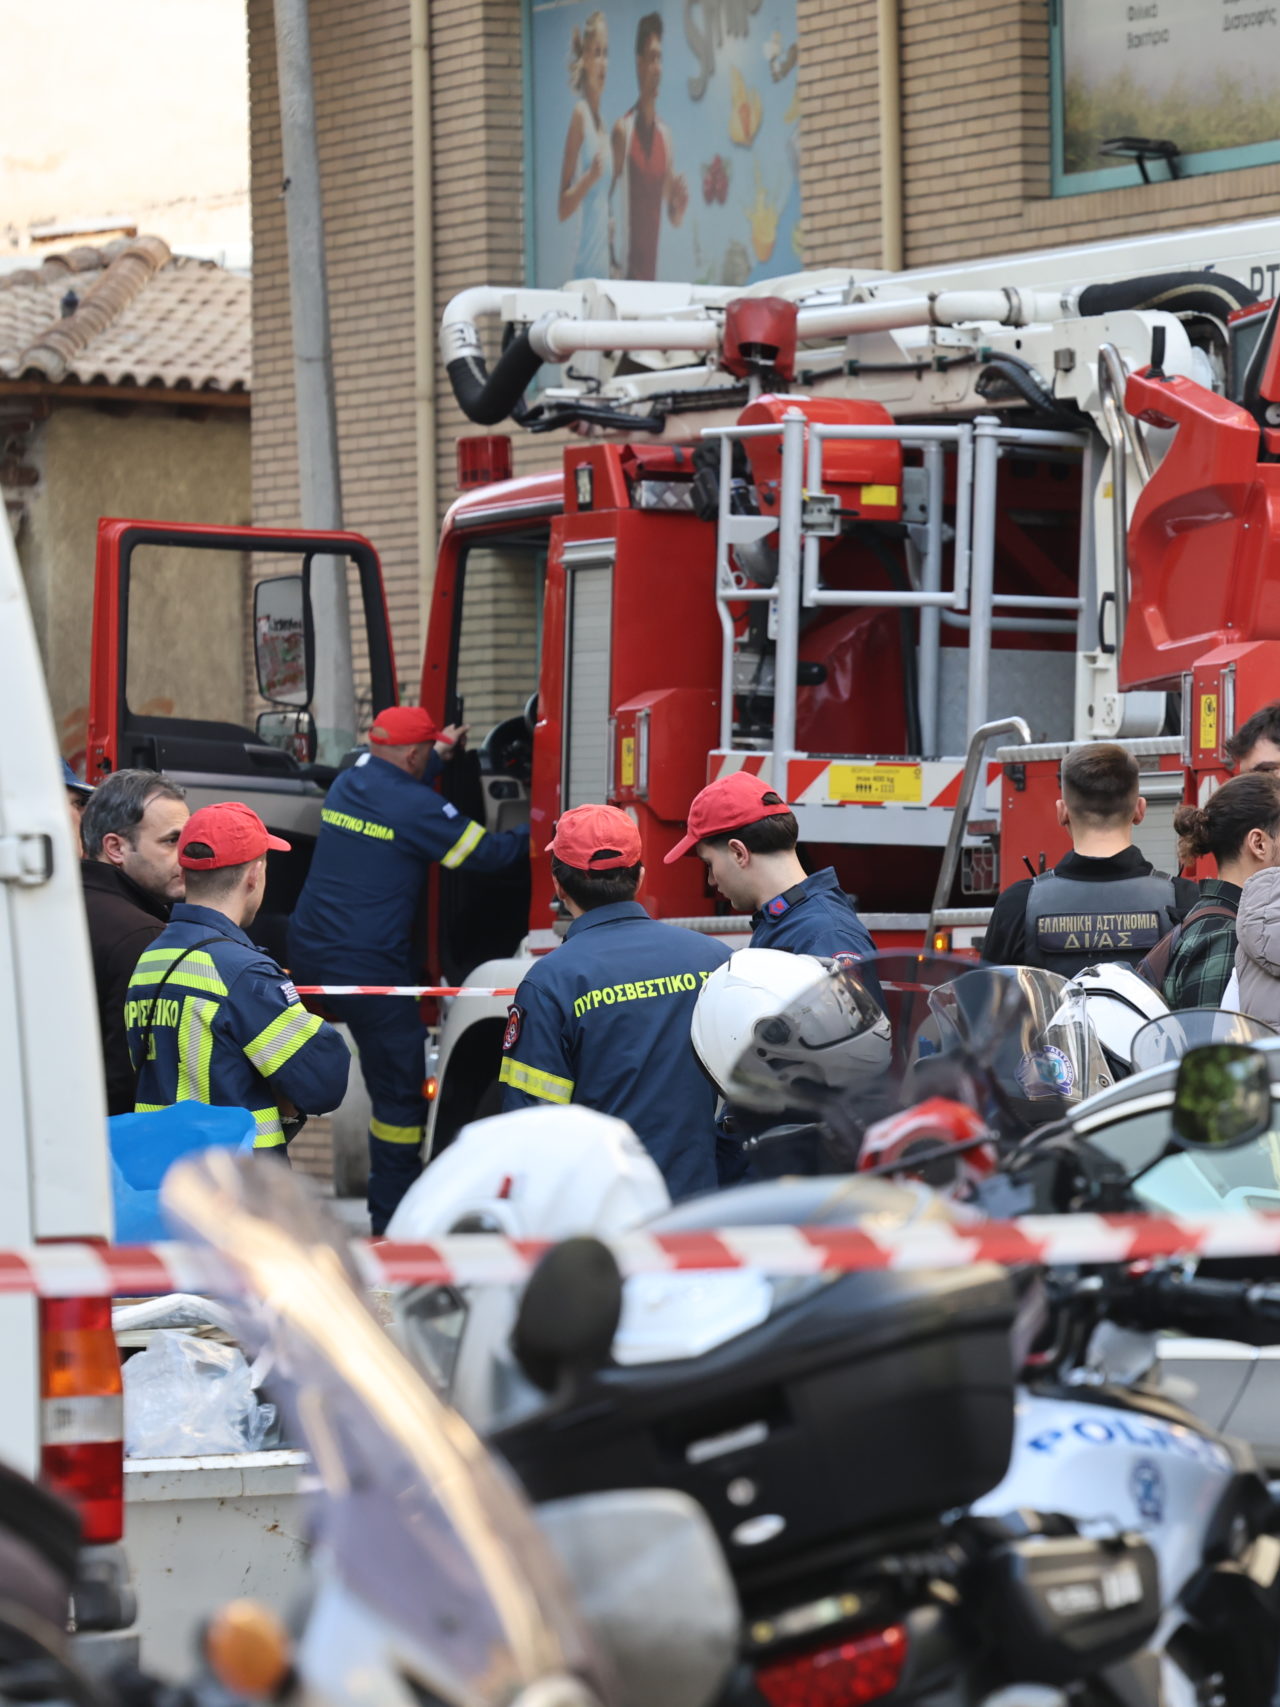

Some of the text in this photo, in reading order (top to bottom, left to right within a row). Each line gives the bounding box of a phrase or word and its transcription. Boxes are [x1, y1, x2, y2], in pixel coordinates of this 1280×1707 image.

[1038, 913, 1159, 933] ΕΛΛΗΝΙΚΗ ΑΣΤΥΝΟΜΙΑ
[573, 973, 697, 1018] ΠΥΡΟΣΒΕΣΤΙΚΟ
